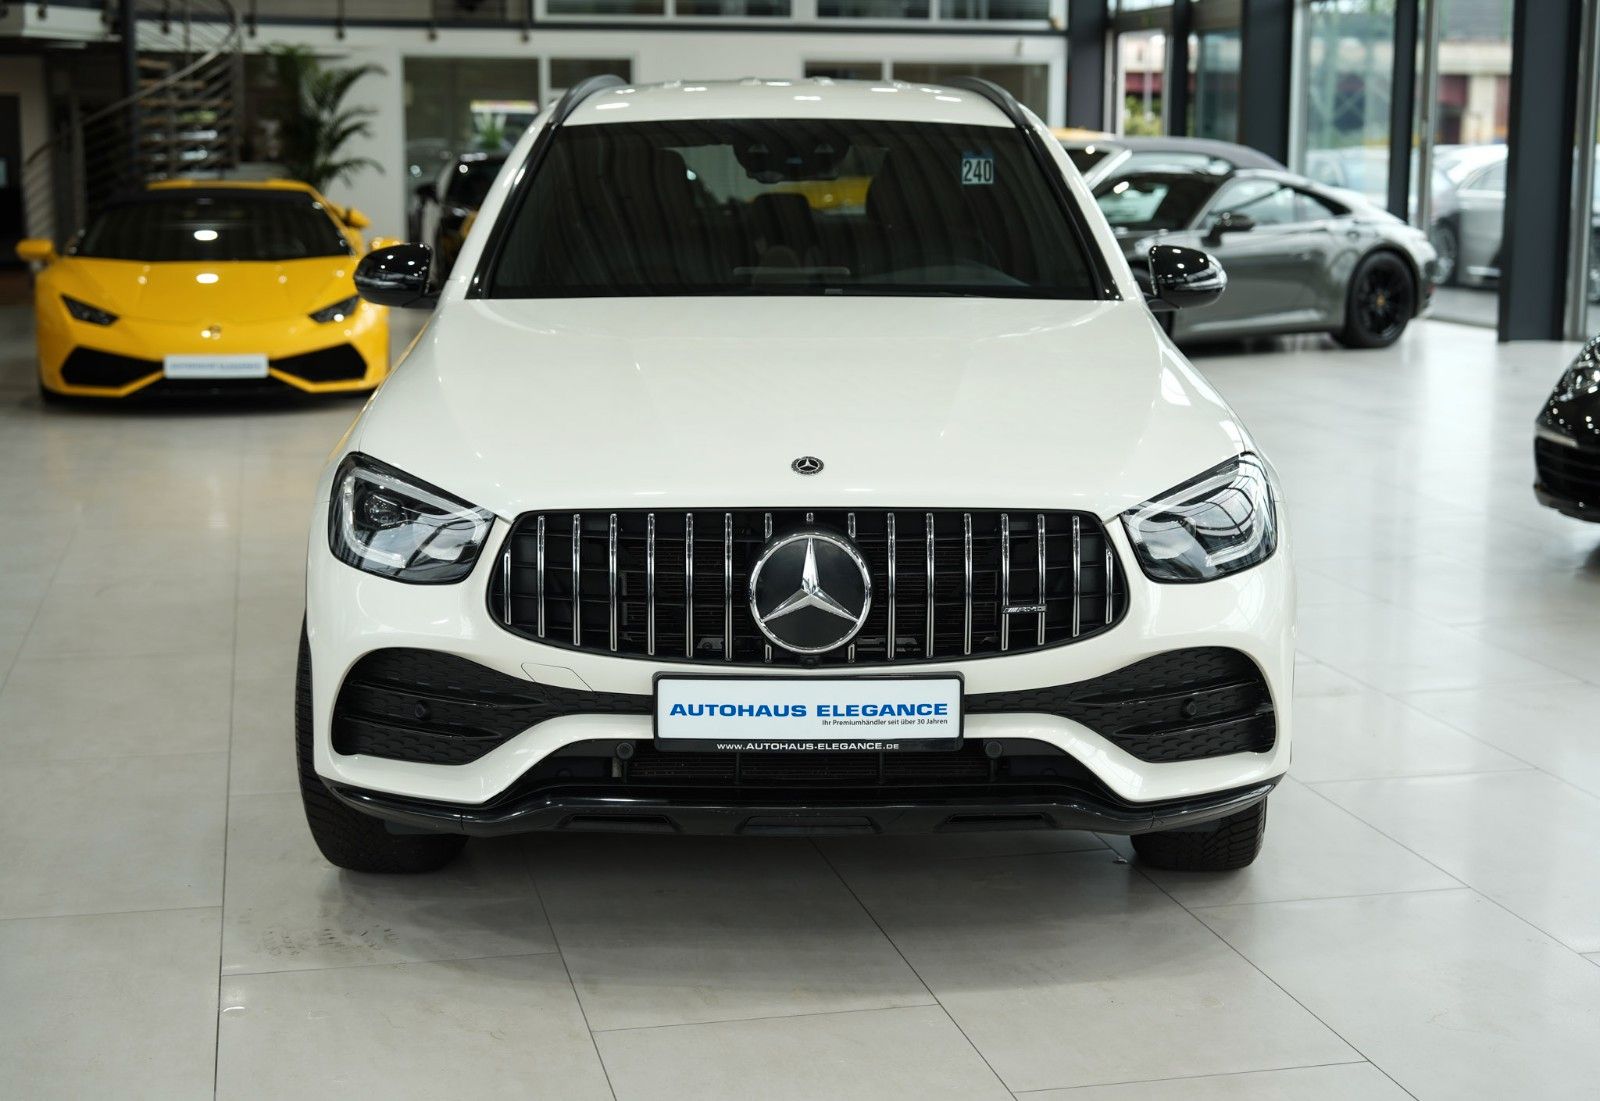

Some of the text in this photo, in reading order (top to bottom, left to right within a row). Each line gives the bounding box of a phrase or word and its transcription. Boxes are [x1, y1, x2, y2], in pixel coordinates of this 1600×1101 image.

[964, 160, 992, 182] 240
[670, 703, 948, 717] AUTOHAUS ELEGANCE
[901, 717, 915, 725] über
